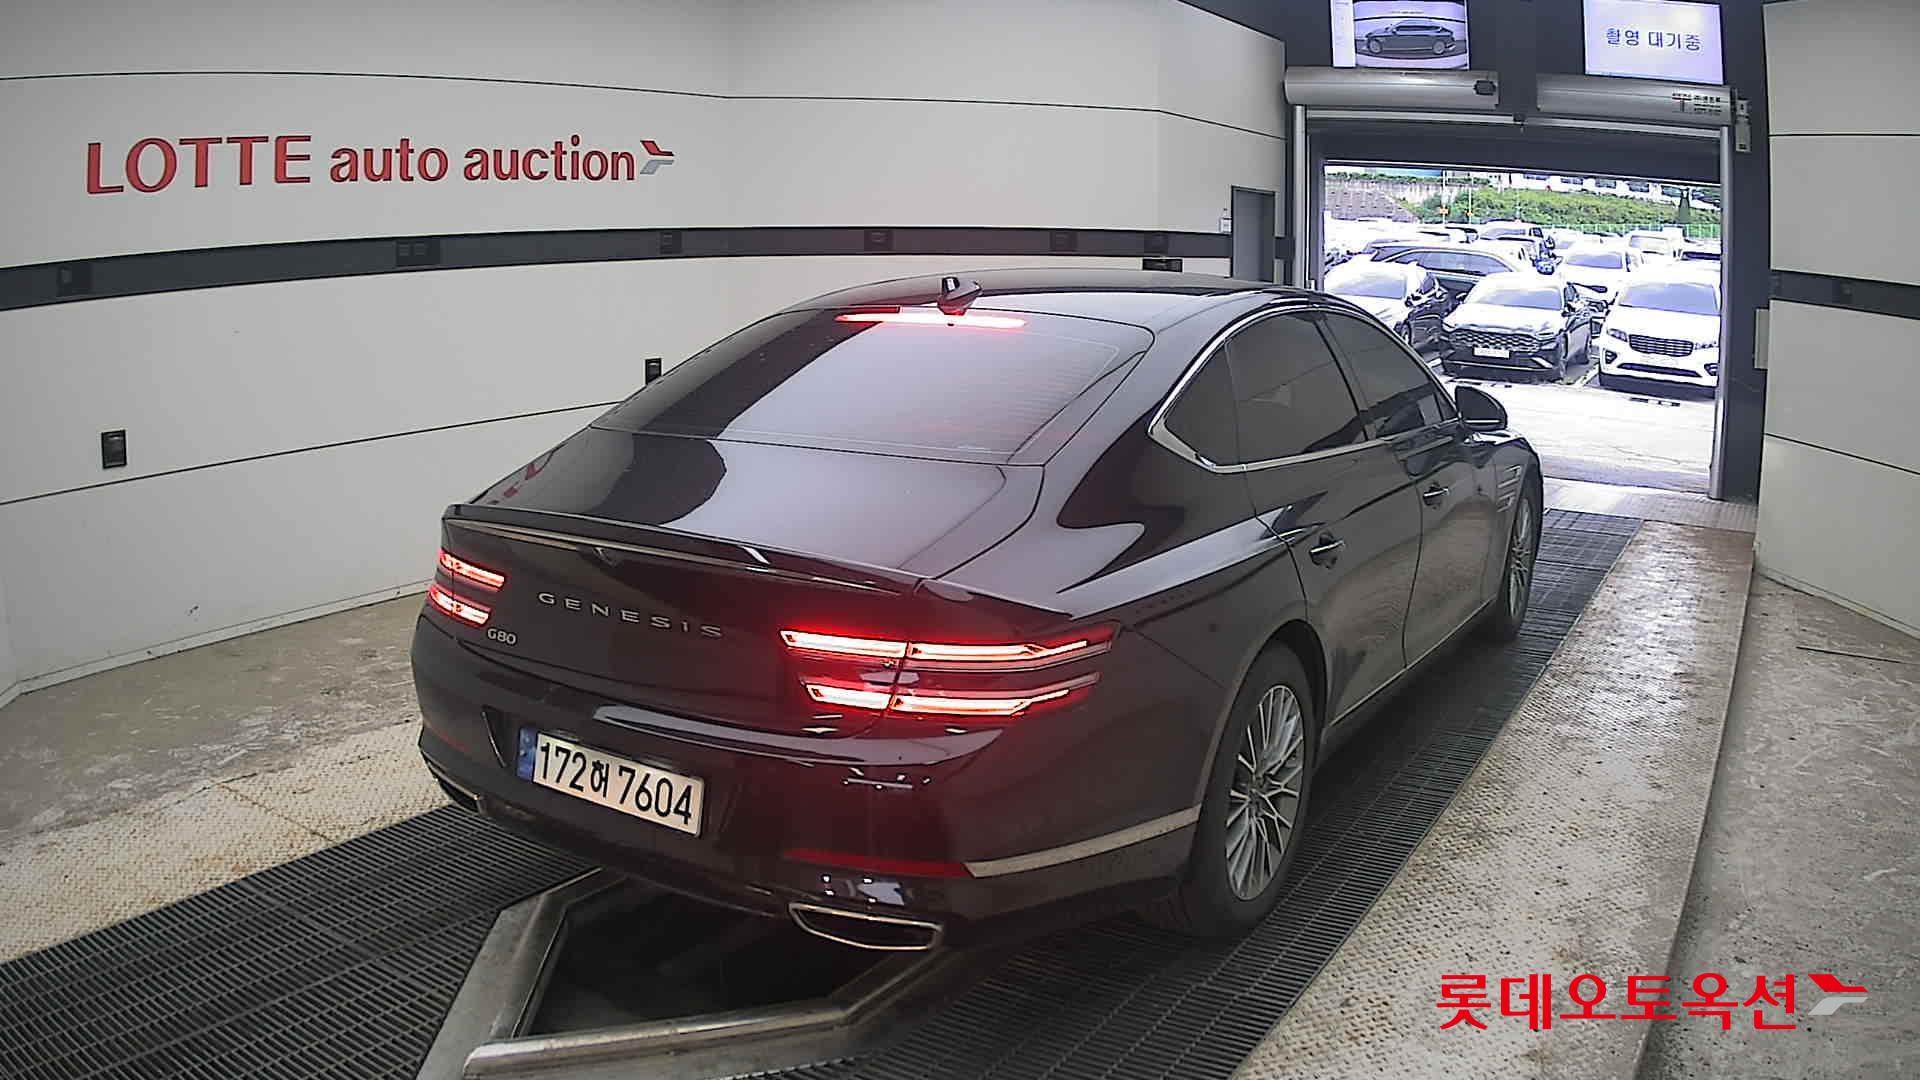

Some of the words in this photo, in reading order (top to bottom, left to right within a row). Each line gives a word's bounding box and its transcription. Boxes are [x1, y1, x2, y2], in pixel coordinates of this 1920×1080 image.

[1647, 31, 1702, 51] 대기중
[86, 135, 311, 194] LOTTE
[329, 138, 449, 182] auto
[463, 135, 636, 182] auction
[538, 592, 722, 637] GENESIS
[487, 628, 517, 645] G80
